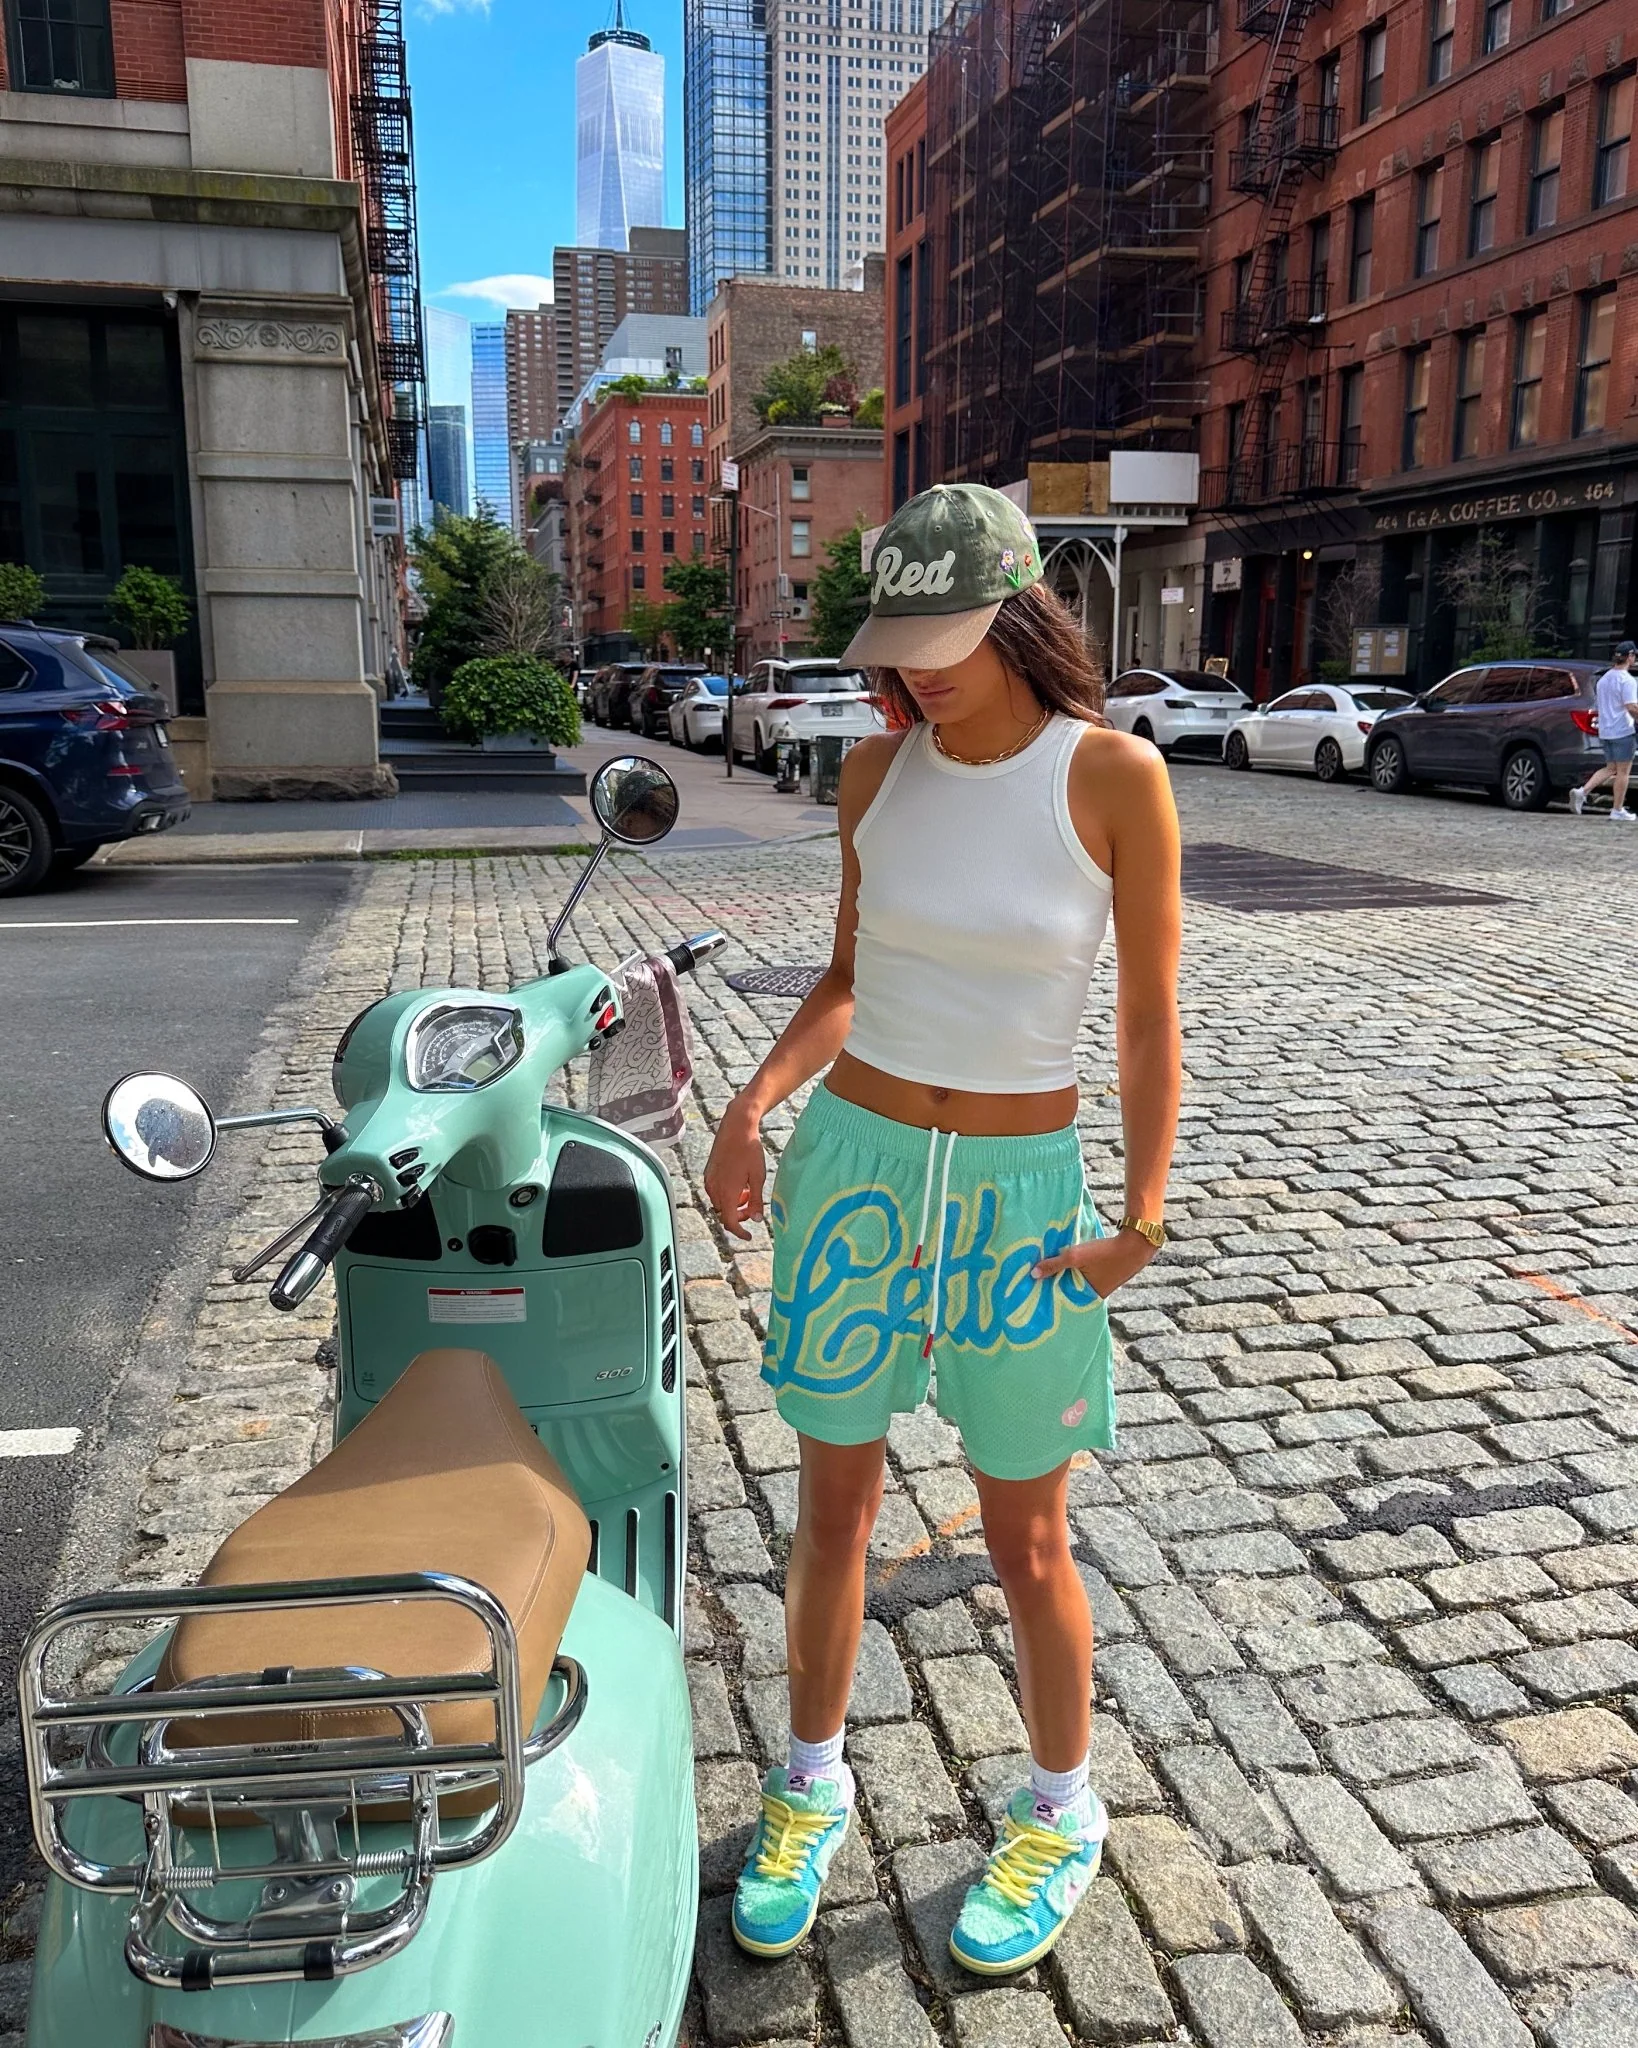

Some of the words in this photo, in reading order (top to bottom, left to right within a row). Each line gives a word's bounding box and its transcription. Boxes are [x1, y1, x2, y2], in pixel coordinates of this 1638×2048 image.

[1449, 493, 1521, 522] COFFEE
[1584, 481, 1614, 501] 464
[871, 546, 956, 605] Red
[596, 1366, 633, 1380] 300
